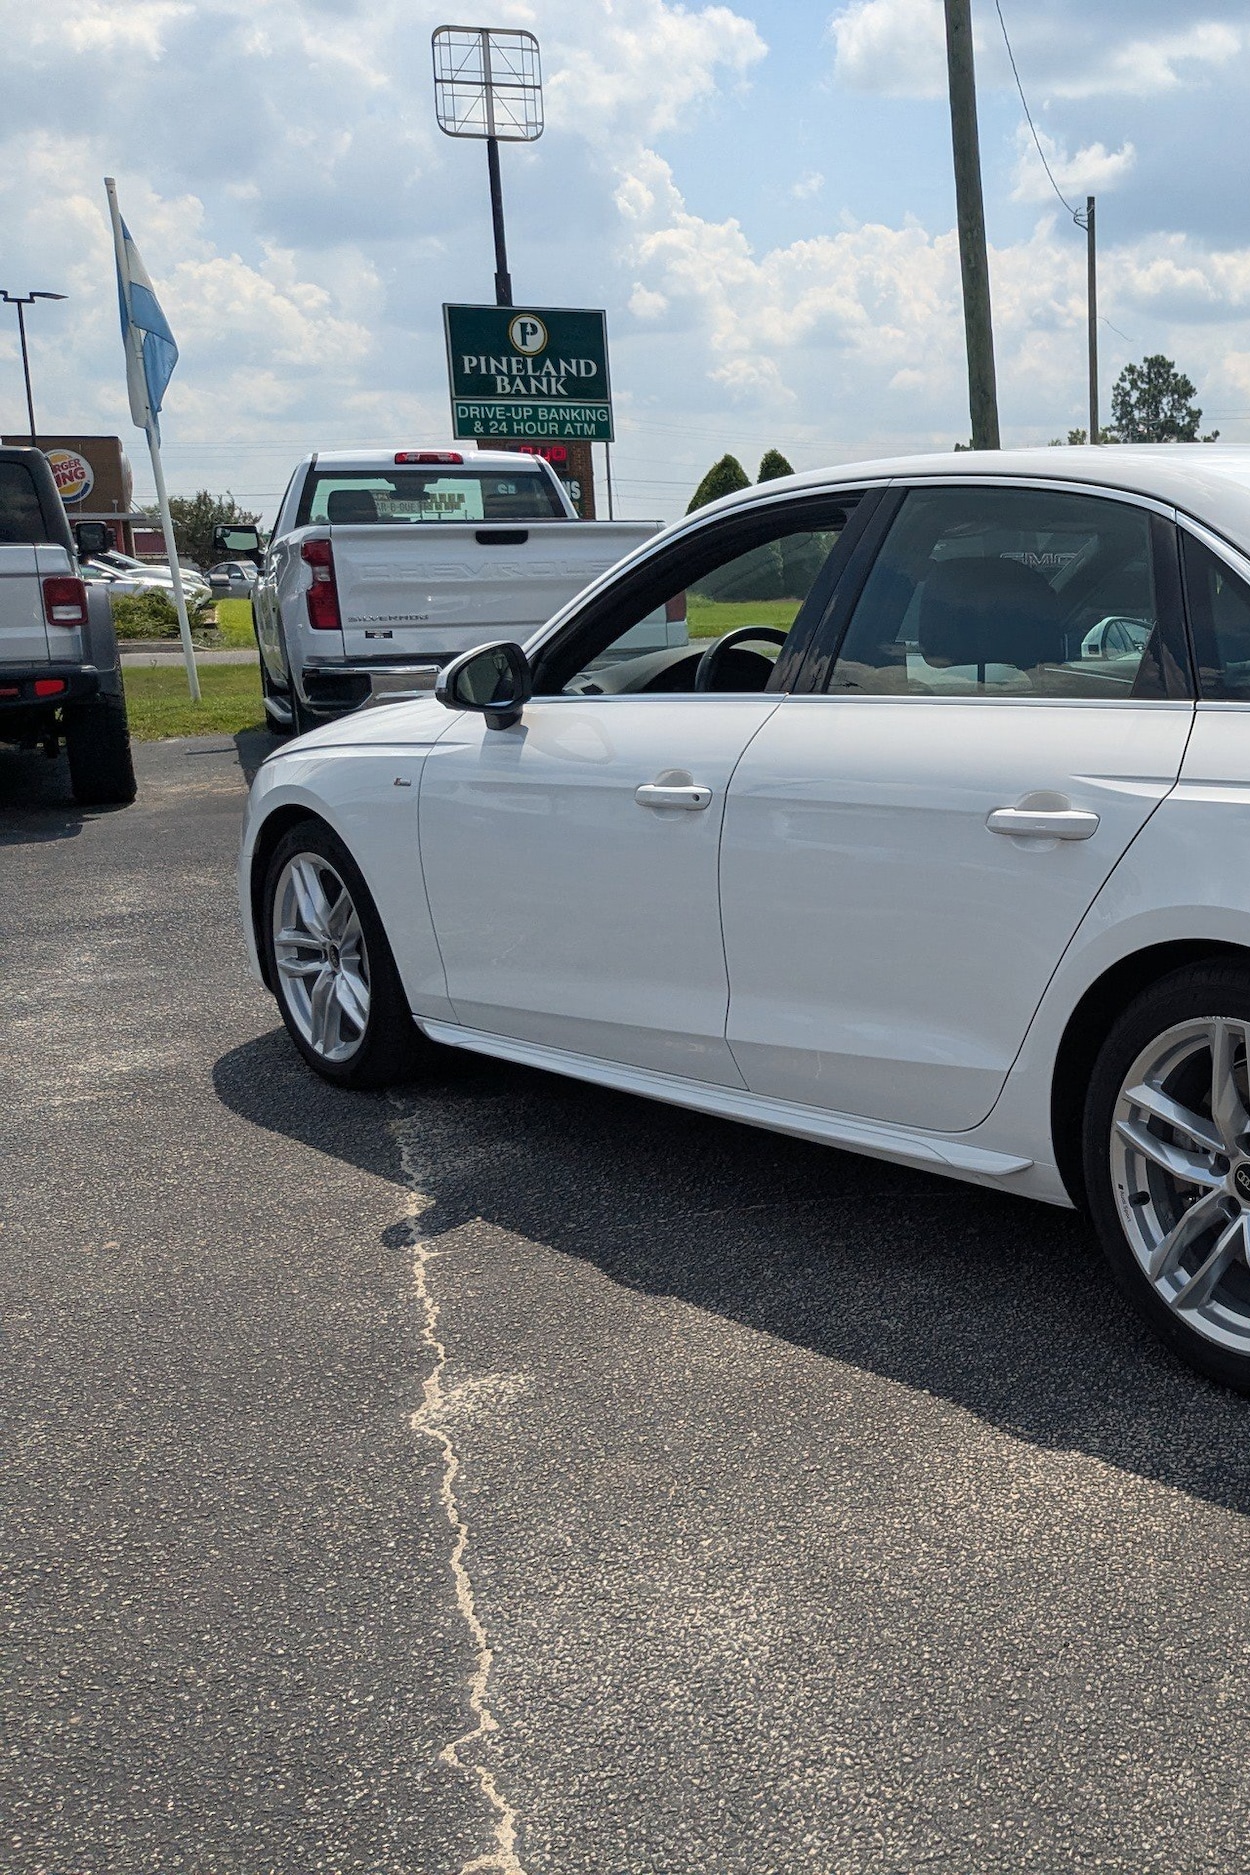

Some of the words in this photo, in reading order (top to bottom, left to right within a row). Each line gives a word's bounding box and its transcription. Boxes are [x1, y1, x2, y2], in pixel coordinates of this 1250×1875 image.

[462, 355, 598, 378] PINELAND
[496, 376, 568, 395] BANK
[458, 406, 533, 420] DRIVE-UP
[538, 408, 608, 421] BANKING
[473, 421, 484, 433] &
[489, 421, 508, 434] 24
[514, 422, 559, 434] HOUR
[564, 423, 596, 435] ATM
[52, 459, 81, 474] RGER
[54, 467, 86, 488] ING
[348, 612, 429, 622] SILVERADO
